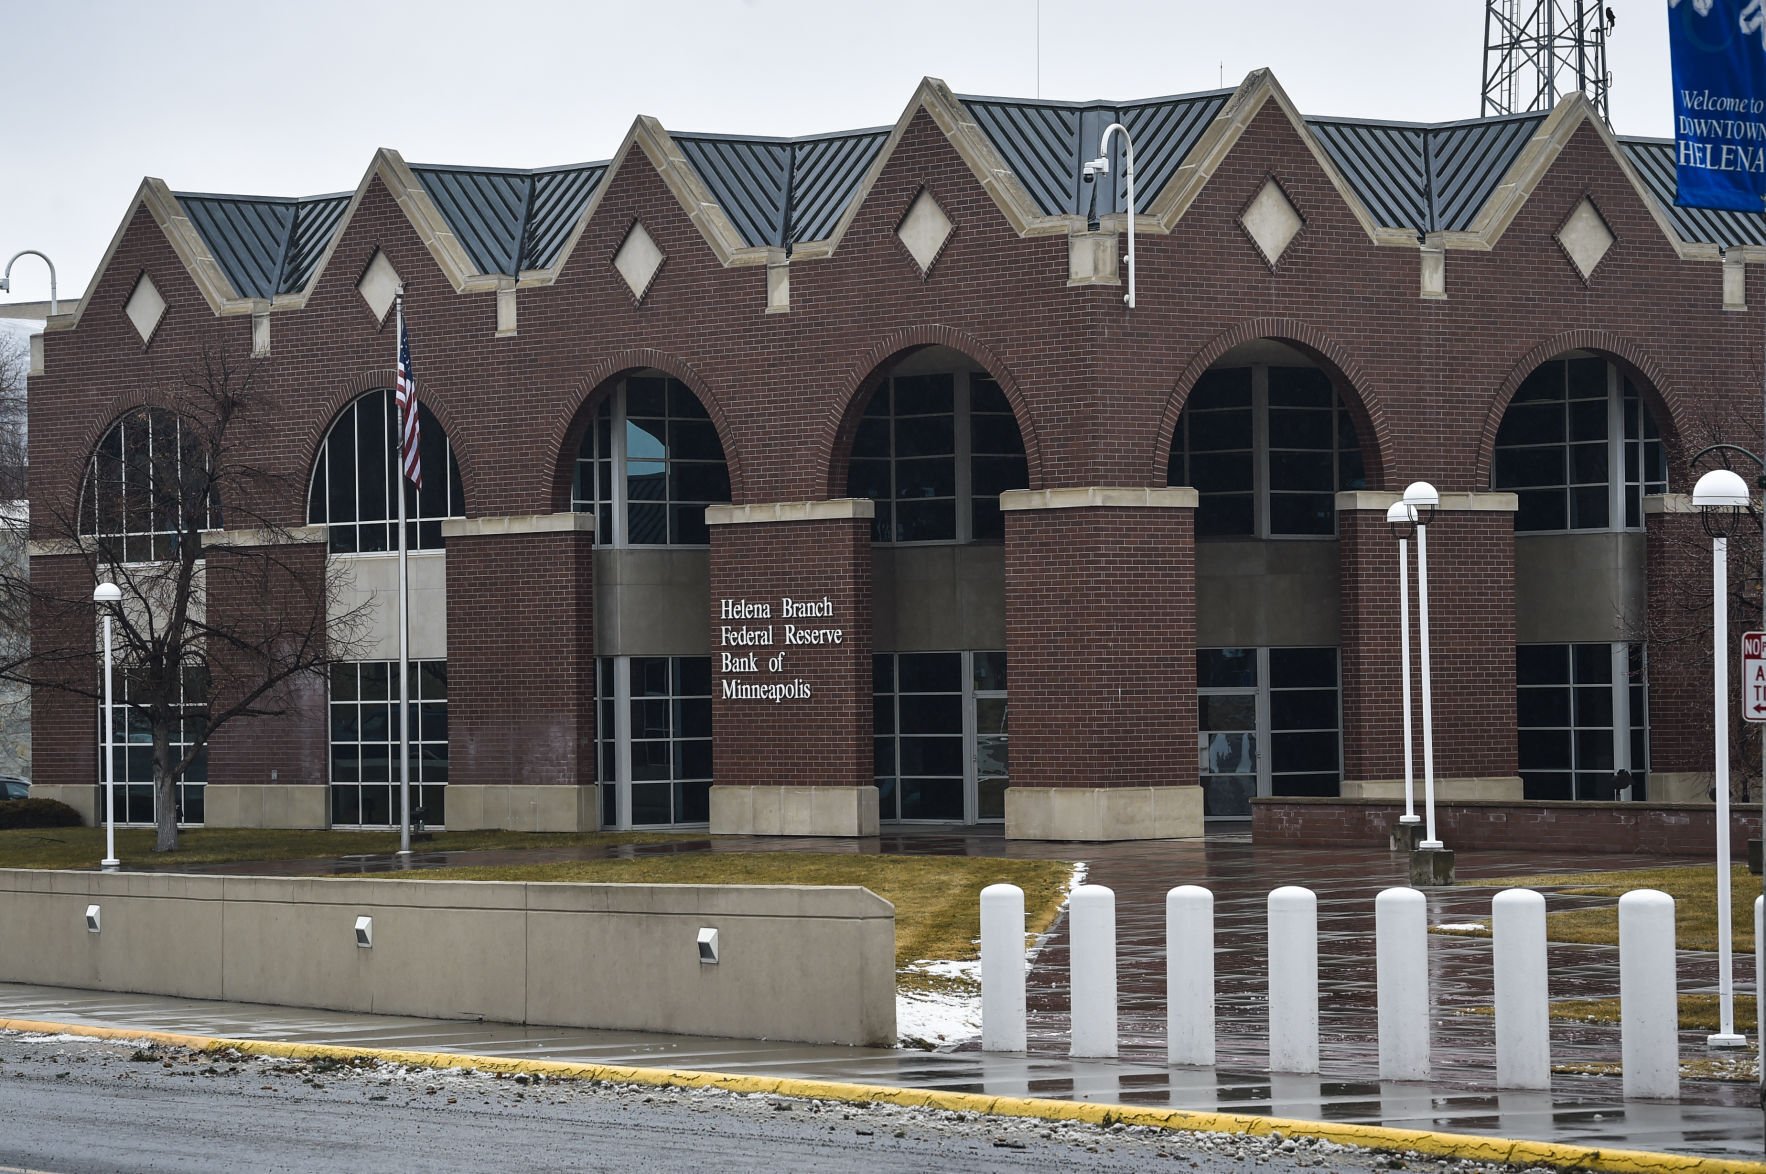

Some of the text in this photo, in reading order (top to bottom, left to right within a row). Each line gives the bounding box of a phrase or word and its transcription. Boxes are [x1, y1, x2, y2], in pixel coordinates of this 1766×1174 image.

[1681, 89, 1764, 114] Welcome to
[1678, 140, 1765, 173] HELENA
[720, 596, 833, 619] Helena Branch
[720, 624, 842, 646] Federal Reserve
[1745, 639, 1760, 656] NO
[721, 651, 785, 673] Bank of
[721, 678, 811, 703] Minneapolis
